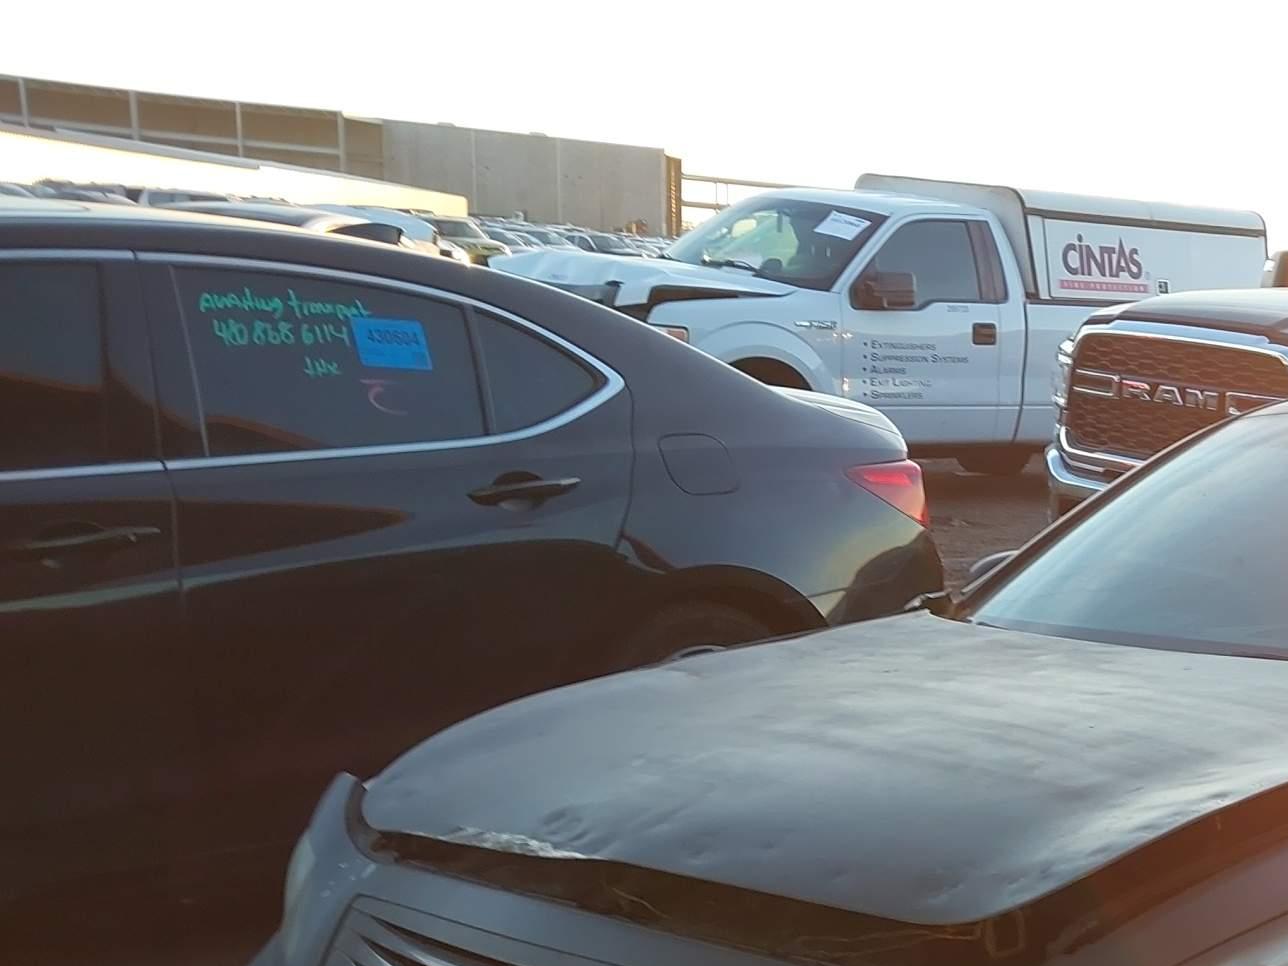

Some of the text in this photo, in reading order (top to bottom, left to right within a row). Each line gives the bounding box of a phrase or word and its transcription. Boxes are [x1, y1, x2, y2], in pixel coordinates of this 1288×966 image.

[1062, 233, 1143, 280] CINTAS
[301, 322, 352, 348] 6114
[1121, 379, 1220, 411] RAM
